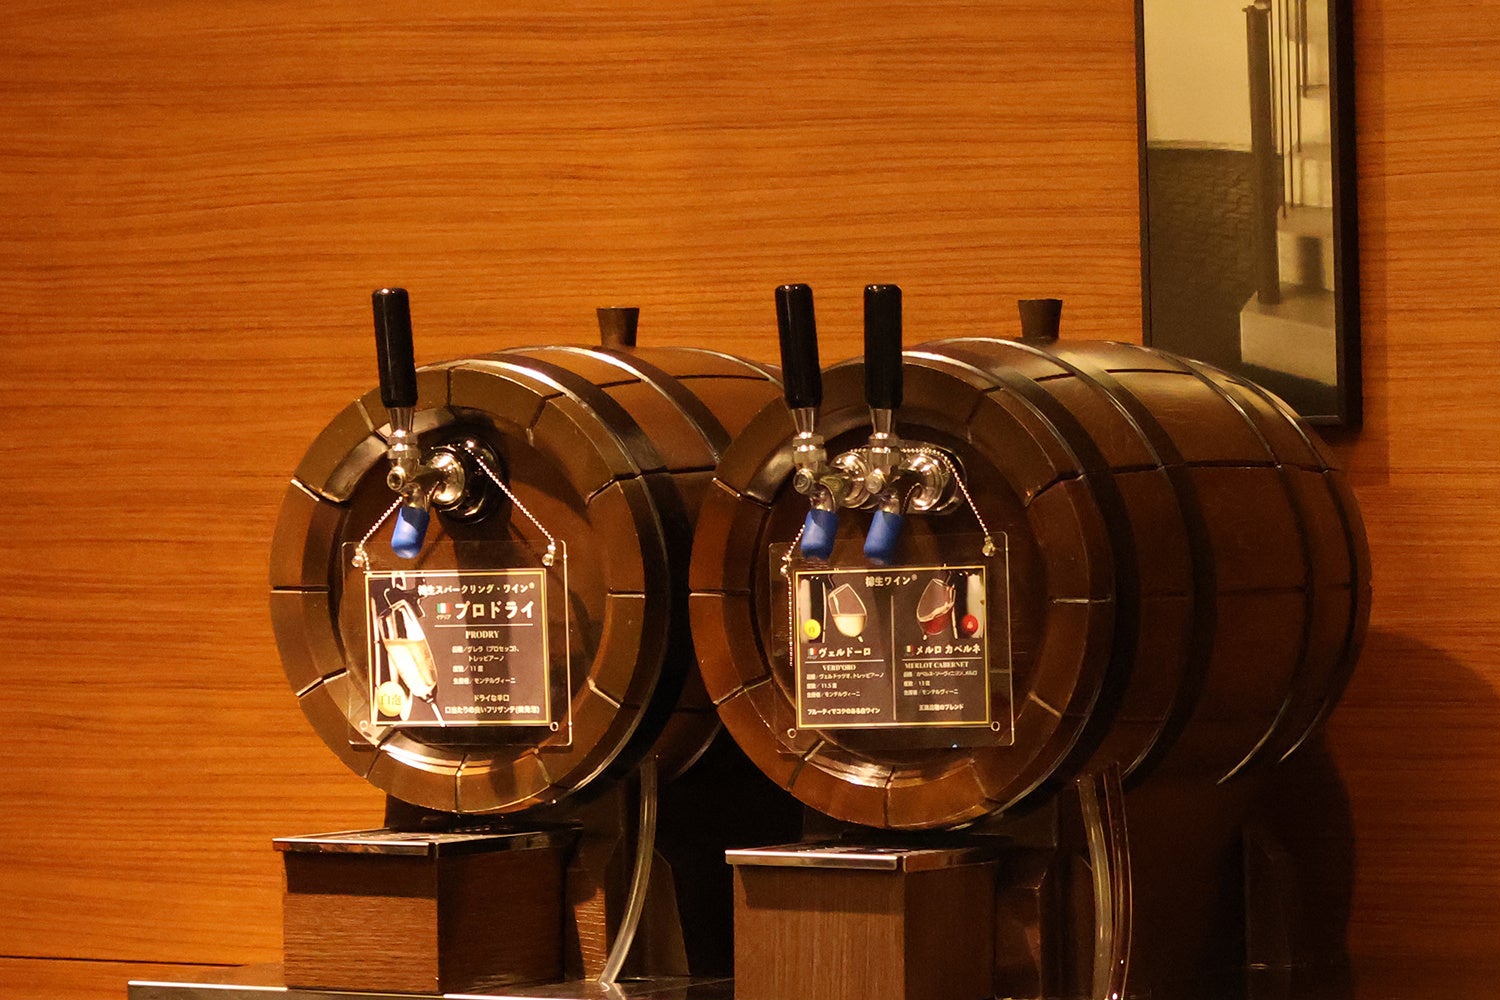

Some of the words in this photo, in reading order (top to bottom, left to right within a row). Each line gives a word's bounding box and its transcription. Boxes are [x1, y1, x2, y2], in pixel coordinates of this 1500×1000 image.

[455, 601, 535, 620] プロドライ
[465, 630, 500, 640] PRODRY
[819, 647, 872, 658] ヴェルドーロ
[916, 645, 942, 655] メルロ
[945, 643, 981, 654] カベルネ
[905, 661, 933, 669] MERLOT
